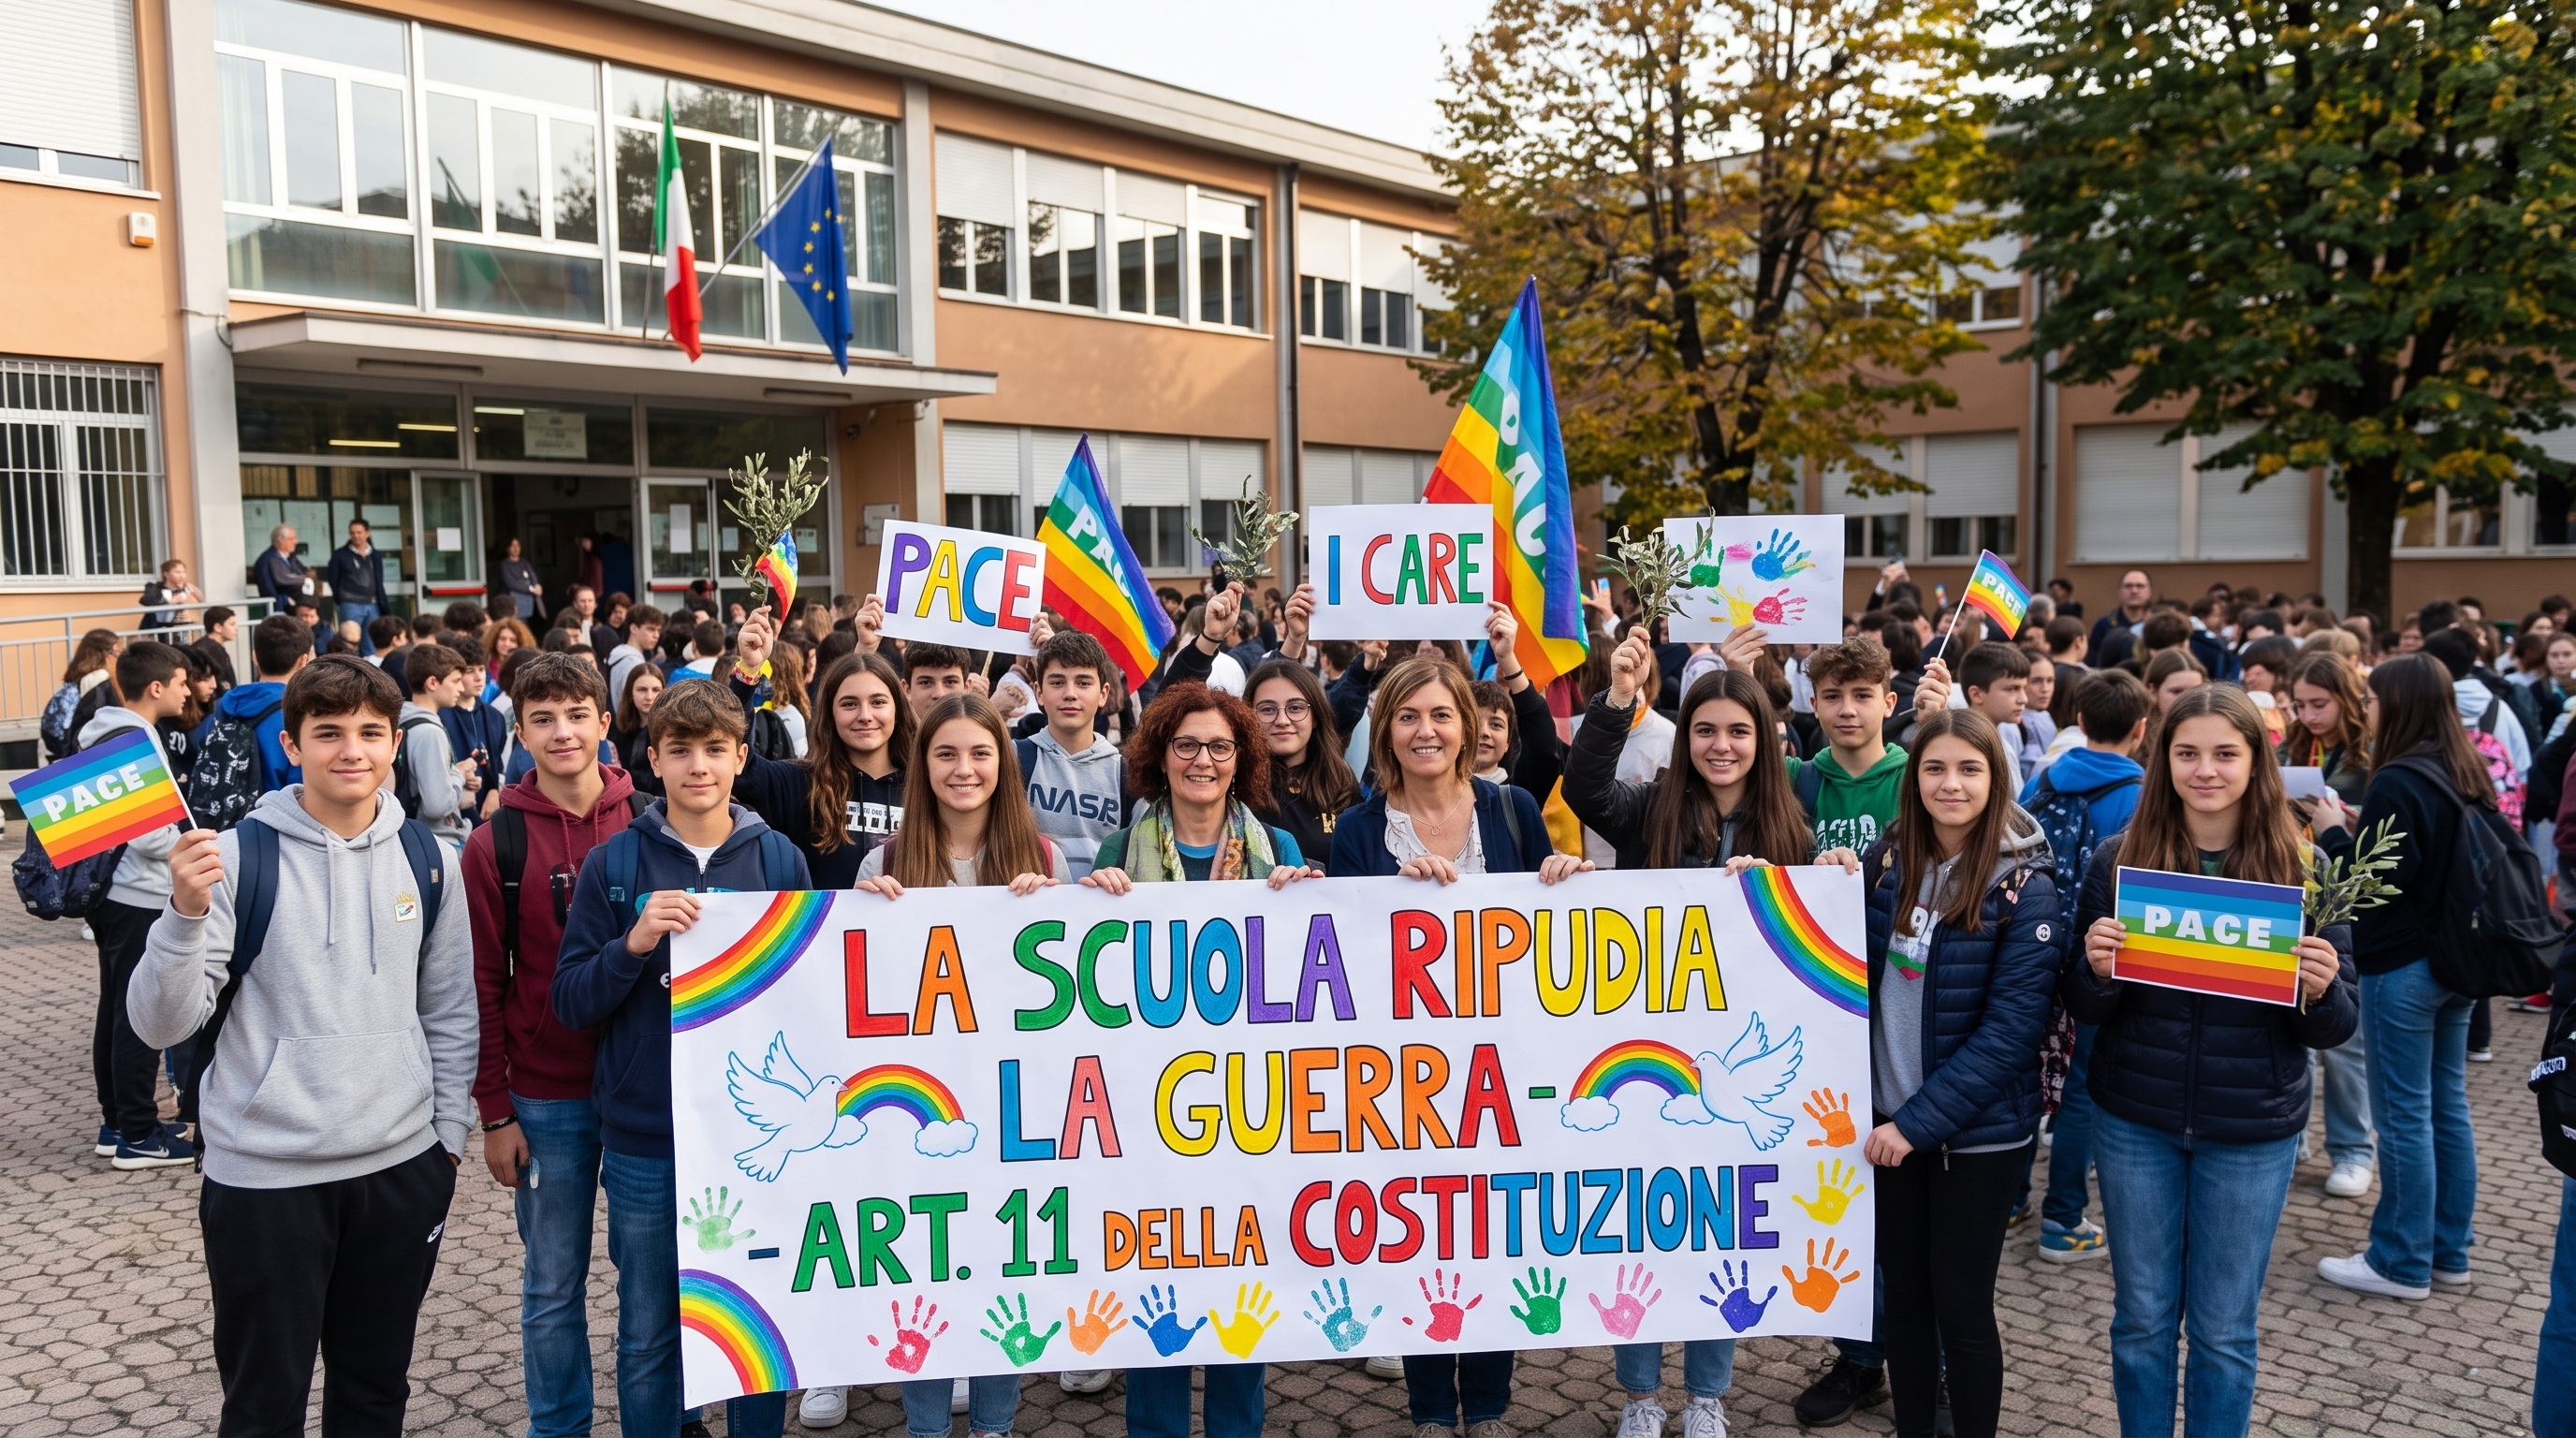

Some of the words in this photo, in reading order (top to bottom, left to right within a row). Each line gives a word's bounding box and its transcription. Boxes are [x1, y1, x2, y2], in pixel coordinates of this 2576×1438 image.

[1500, 390, 1546, 580] PAC
[885, 533, 1037, 633] PACE
[1066, 503, 1134, 601] PAC
[1328, 535, 1340, 605] I
[1361, 533, 1484, 605] CARE
[1981, 572, 2022, 617] PACE
[41, 763, 146, 823] PACE
[843, 925, 979, 1038] LA
[1013, 914, 1356, 1031] SCUOLA
[1390, 905, 1727, 1020] RIPUDIA
[2144, 904, 2272, 949] PACE
[999, 1055, 1123, 1162] LA
[995, 1186, 1078, 1278] 11
[1104, 1205, 1268, 1271] DELLA
[1289, 1164, 1778, 1268] COSTITUZIONE
